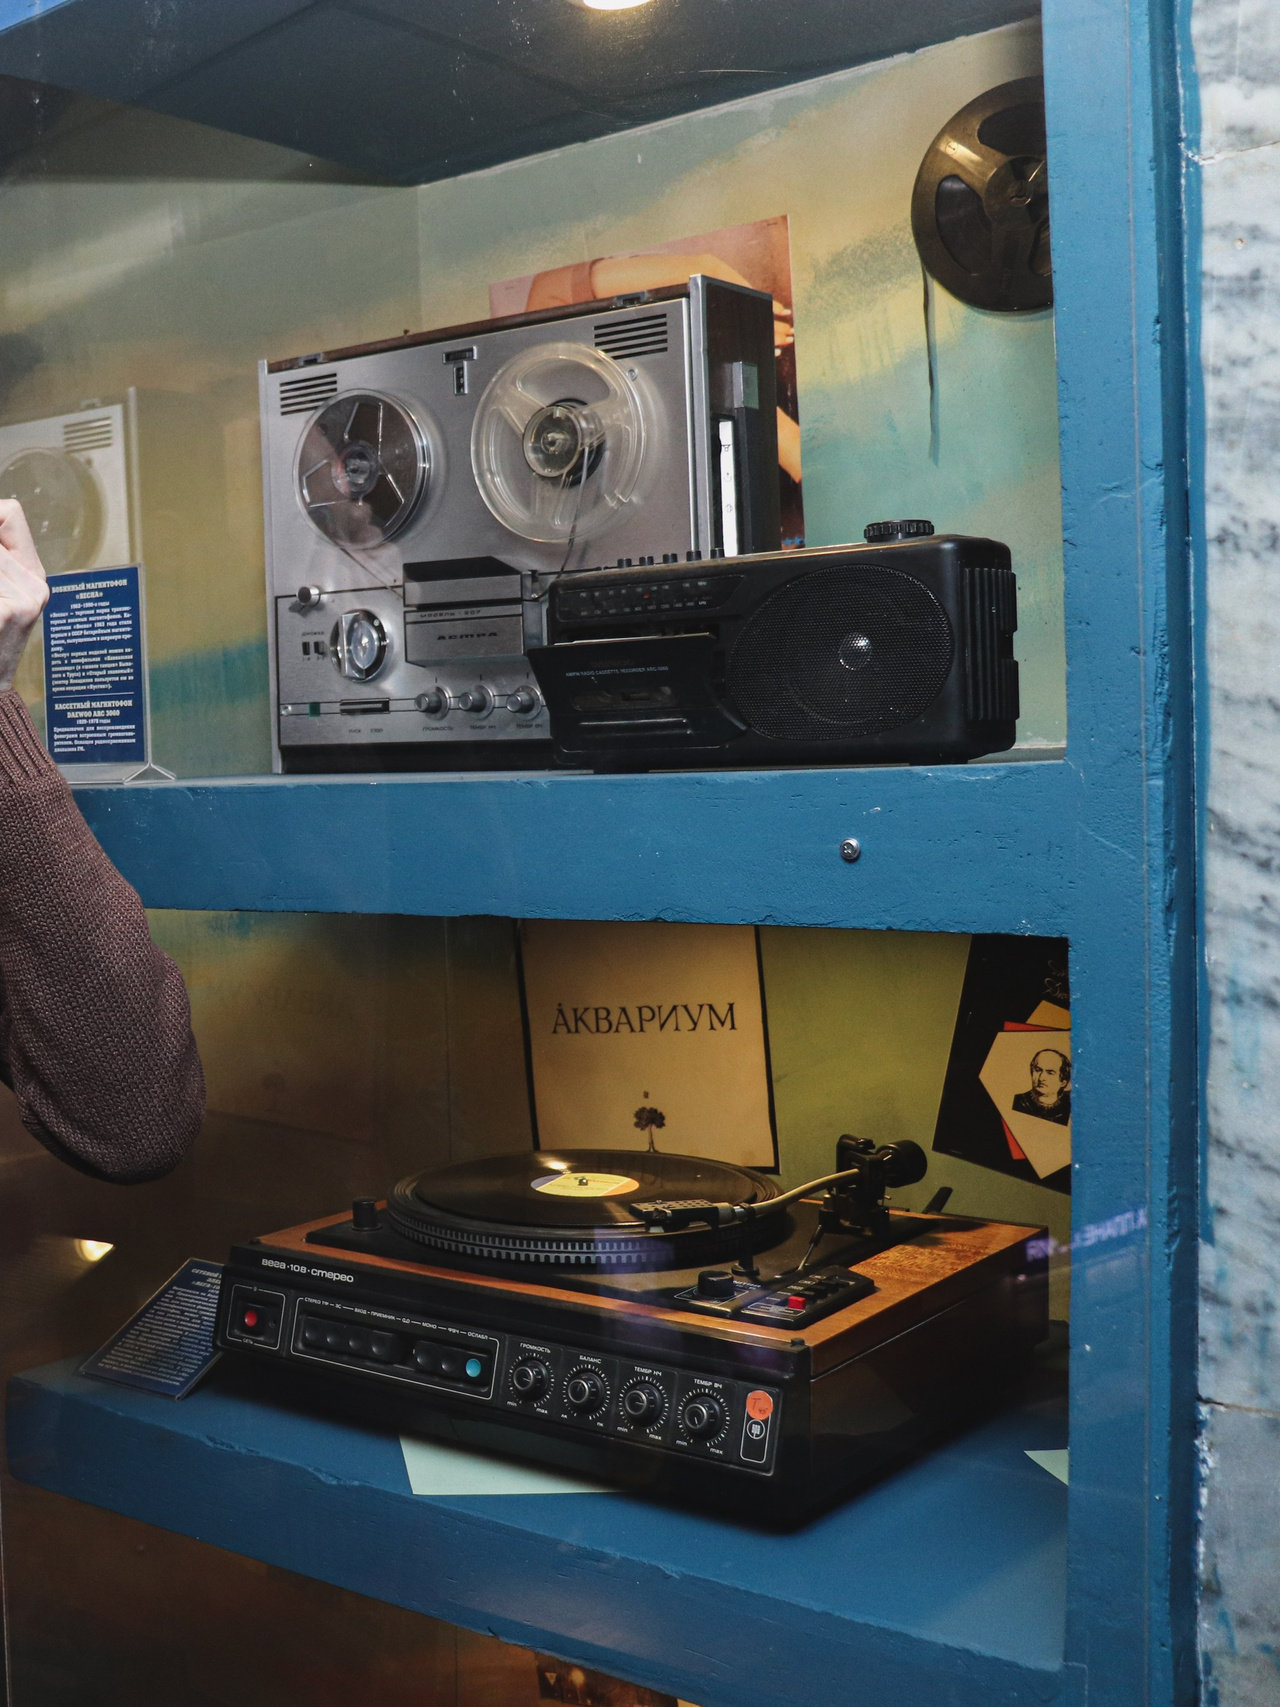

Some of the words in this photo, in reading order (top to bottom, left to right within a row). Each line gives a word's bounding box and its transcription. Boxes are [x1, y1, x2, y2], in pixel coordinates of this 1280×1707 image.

[86, 579, 127, 590] МАГНИТОФОН
[55, 701, 90, 710] КАССЕТНЫЙ
[91, 700, 133, 708] МАГНИТОФОН
[520, 1342, 551, 1354] ГРОМКОСТЬ
[579, 1354, 602, 1364] БАЛАНС
[634, 1366, 653, 1375] ТЕМБР
[693, 1378, 713, 1387] ТЕМБР
[536, 1406, 548, 1415] max
[649, 1433, 662, 1441] max
[675, 1439, 688, 1447] min
[710, 1447, 723, 1455] max
